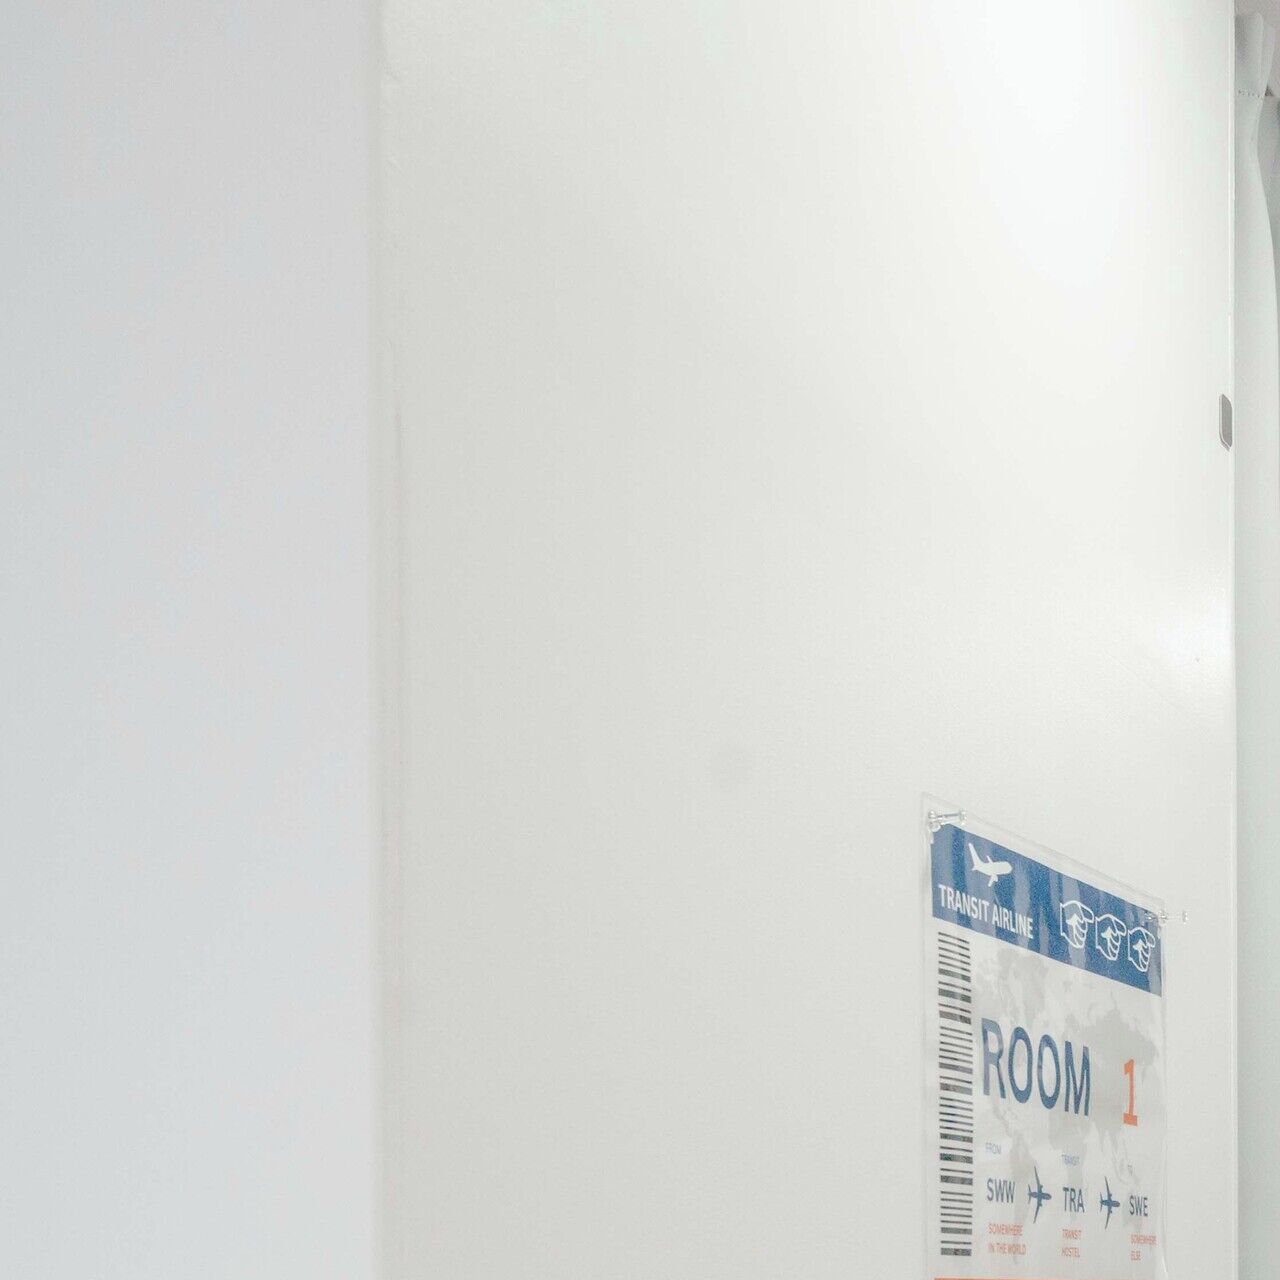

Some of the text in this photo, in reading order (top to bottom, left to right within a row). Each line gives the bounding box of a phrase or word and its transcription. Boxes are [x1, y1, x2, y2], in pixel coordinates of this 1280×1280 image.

[938, 883, 1034, 940] TRANSIT AIRLINE
[981, 1017, 1138, 1127] ROOM 1
[986, 1177, 1149, 1217] SWW TRA SWE
[988, 1222, 1024, 1237] SOMEWHERE
[1008, 1244, 1027, 1256] WORLD
[1061, 1247, 1081, 1259] HOSTEL
